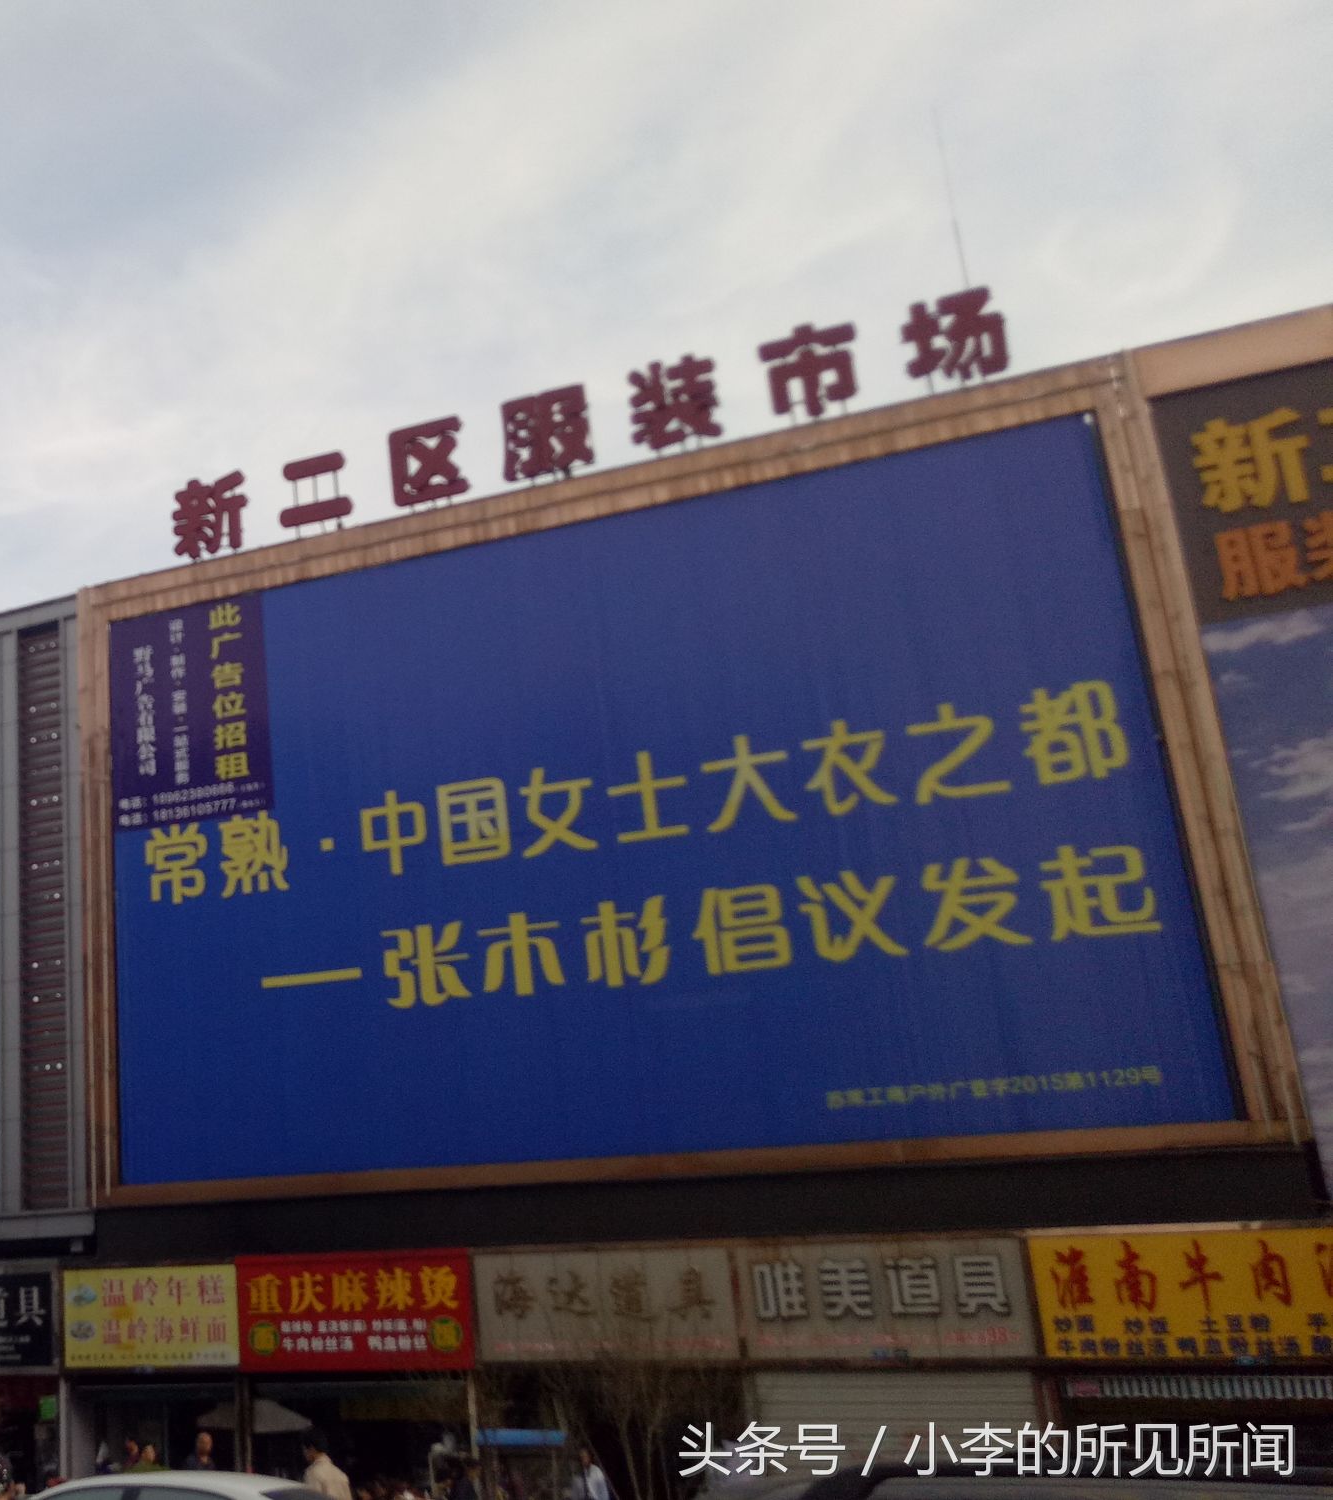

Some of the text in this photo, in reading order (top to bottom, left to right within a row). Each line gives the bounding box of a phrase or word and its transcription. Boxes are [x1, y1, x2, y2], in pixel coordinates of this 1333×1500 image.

[171, 286, 1011, 560] 新二区服装市场
[1190, 405, 1333, 513] 新
[208, 602, 251, 781] 此广告位招租
[101, 1274, 225, 1307] 温岭年糕
[247, 1265, 460, 1316] 重庆麻辣烫
[751, 1254, 1012, 1321] 唯美道具
